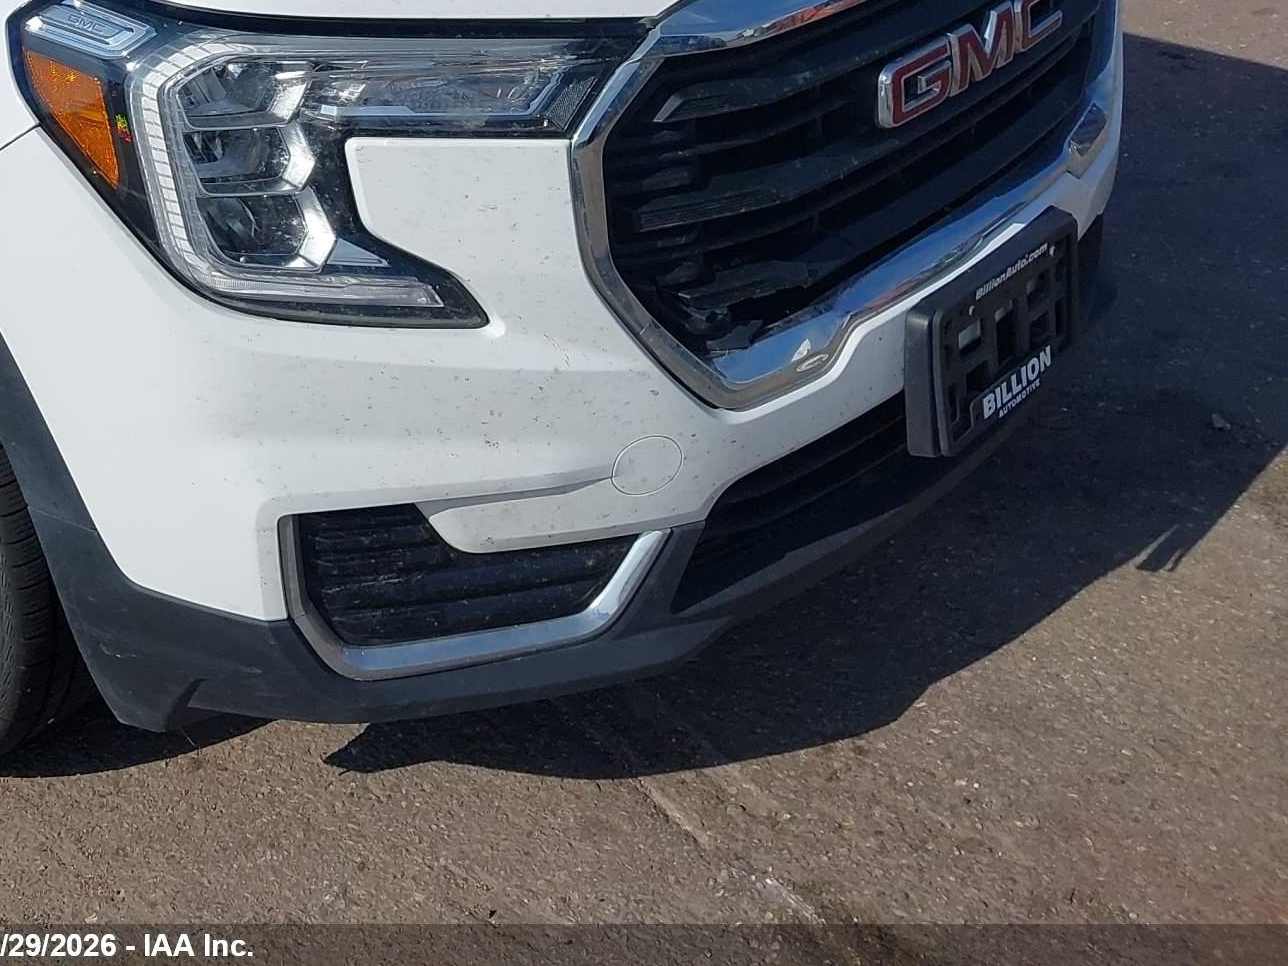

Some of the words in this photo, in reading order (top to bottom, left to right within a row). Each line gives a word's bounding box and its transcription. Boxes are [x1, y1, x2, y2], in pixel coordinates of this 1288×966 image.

[68, 14, 106, 34] GMC
[983, 345, 1052, 420] BILLION
[999, 378, 1041, 419] AUTOMOTIVE
